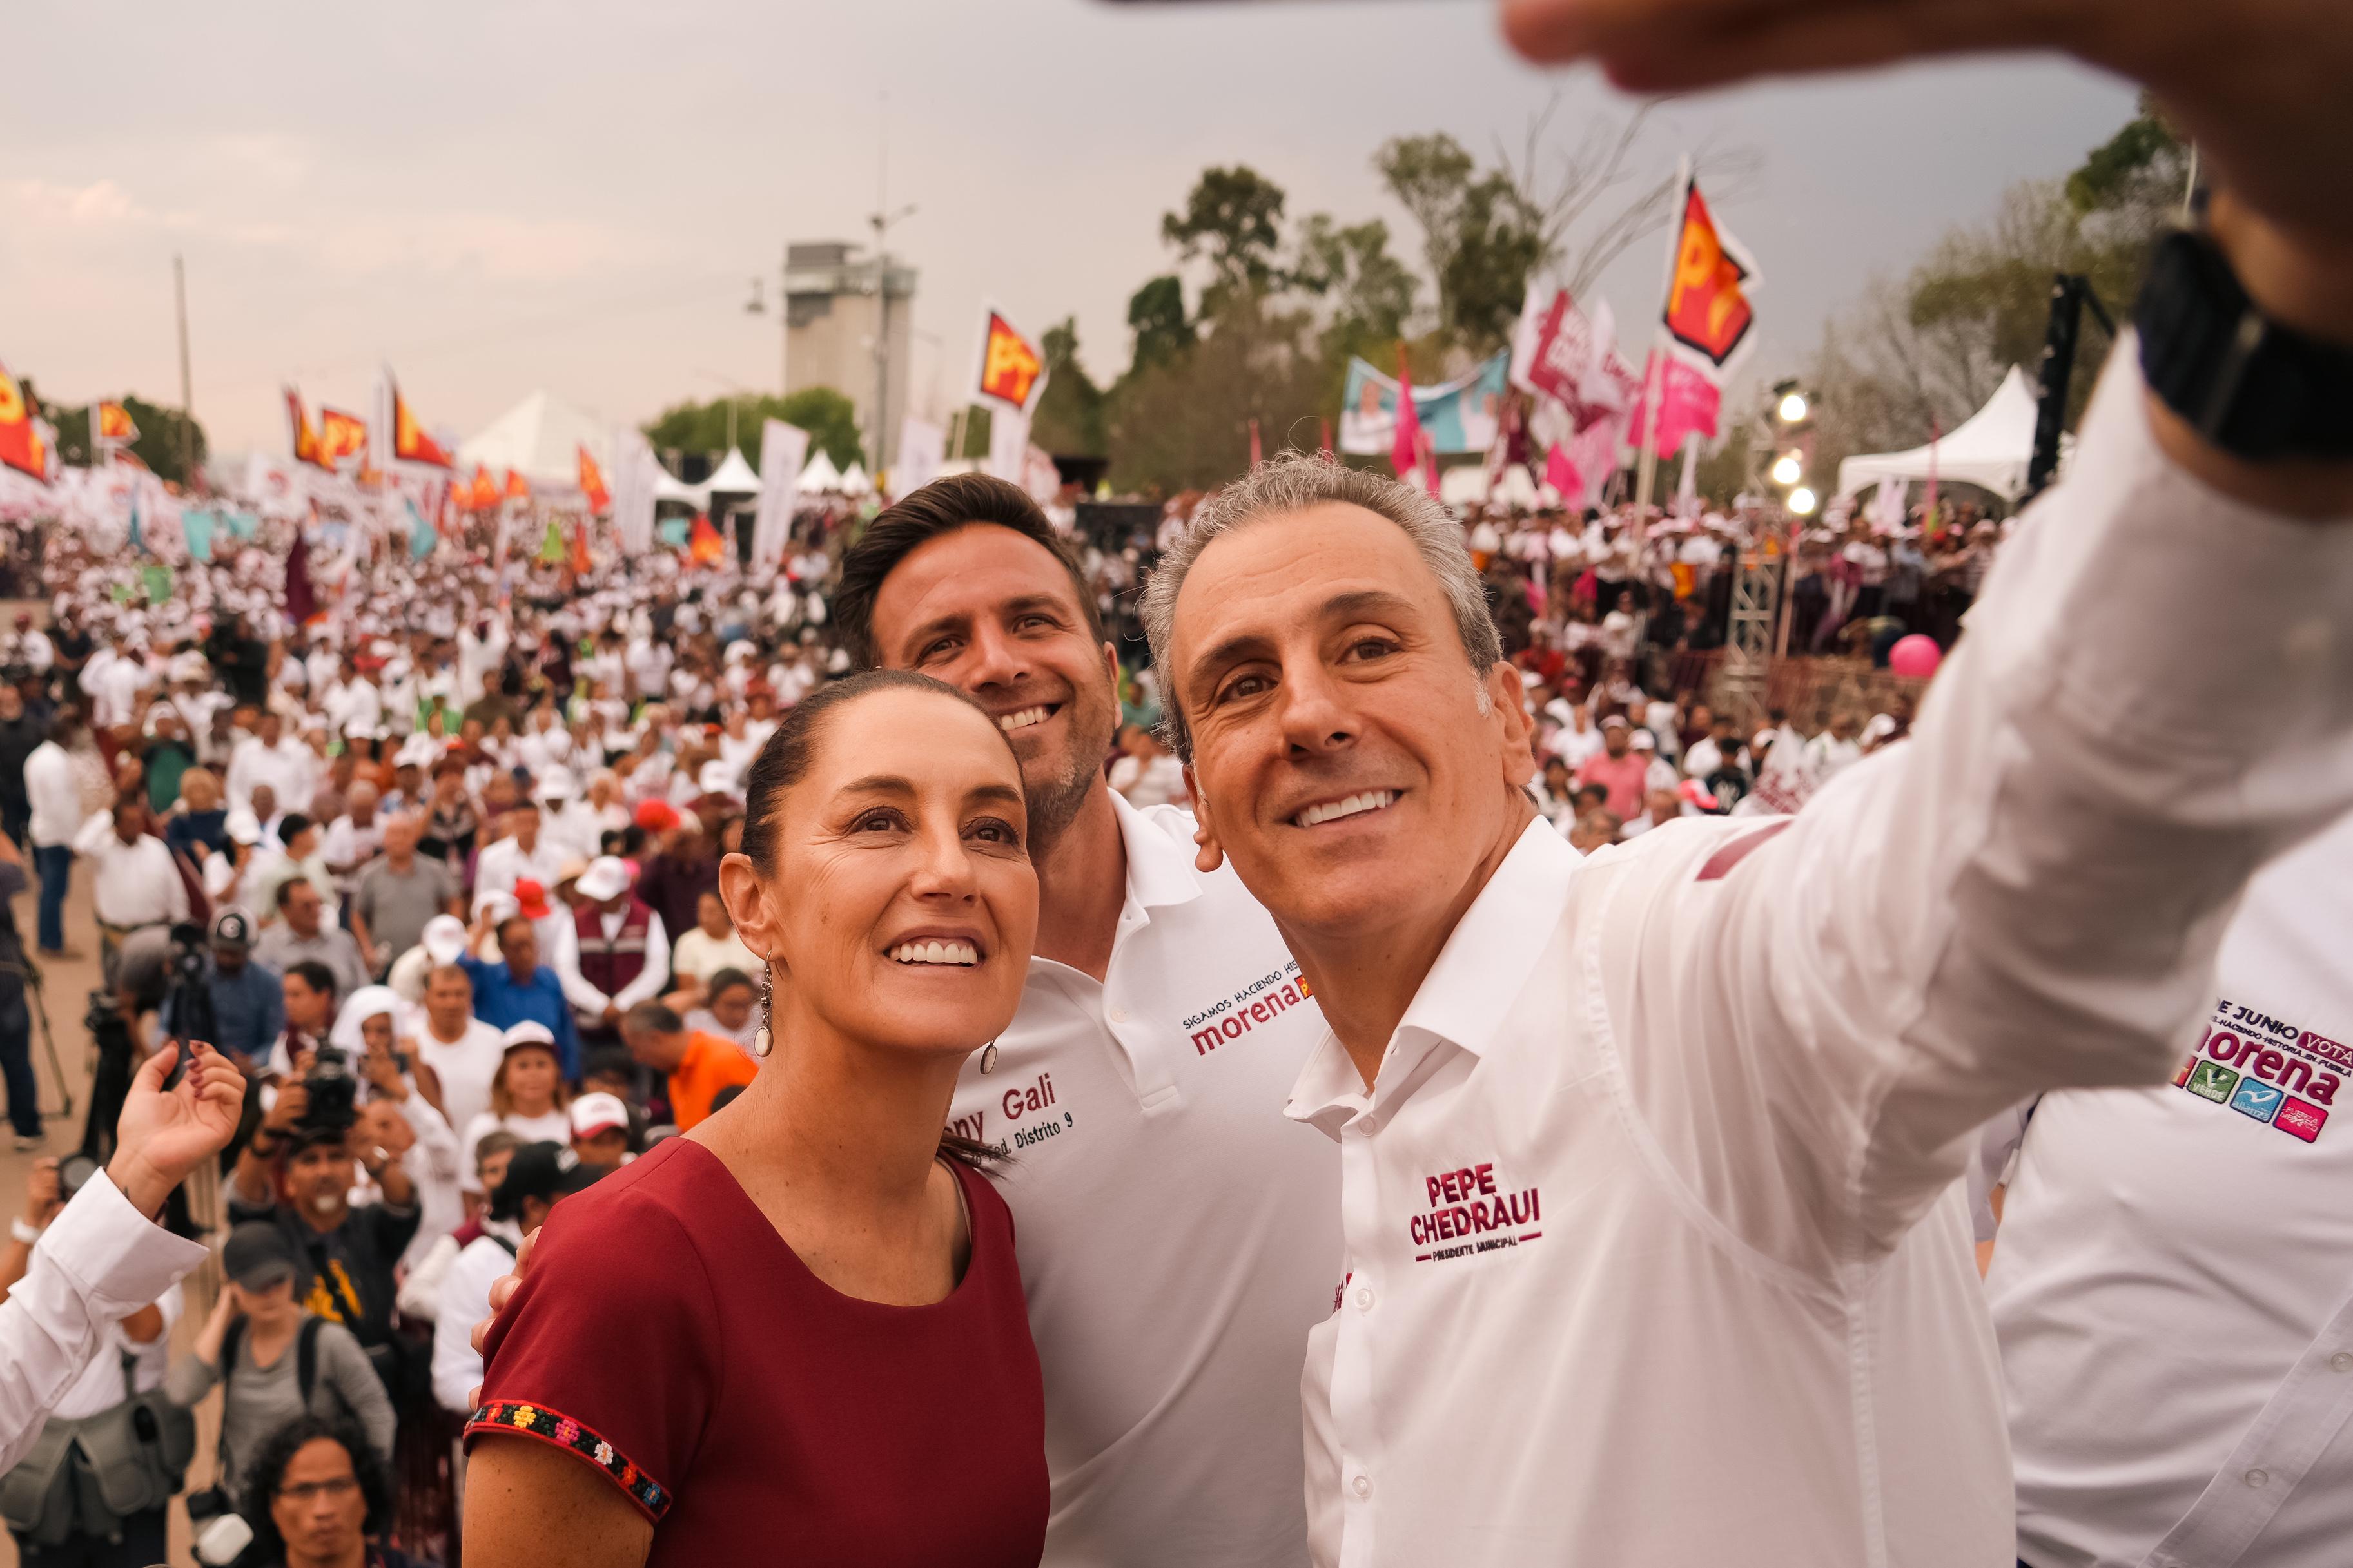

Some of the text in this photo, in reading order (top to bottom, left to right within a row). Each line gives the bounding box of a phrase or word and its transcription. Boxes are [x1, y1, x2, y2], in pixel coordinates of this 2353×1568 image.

[1182, 999, 1232, 1029] SIGAMOS
[1233, 971, 1282, 1003] HACIENDO
[1191, 983, 1301, 1056] morena
[2216, 998, 2353, 1065] E JUNIO VOTA
[2263, 1036, 2302, 1057] HISTORIA
[2305, 1053, 2318, 1063] EN
[1002, 1072, 1056, 1120] Gali
[2192, 1083, 2229, 1103] VERDE
[1014, 1121, 1061, 1149] Distrito
[1064, 1112, 1073, 1128] 9
[1425, 1162, 1498, 1208] PEPE
[1410, 1188, 1541, 1246] CHEDRAUI
[1433, 1235, 1518, 1263] PRESIDENTE MUNICIPAL
